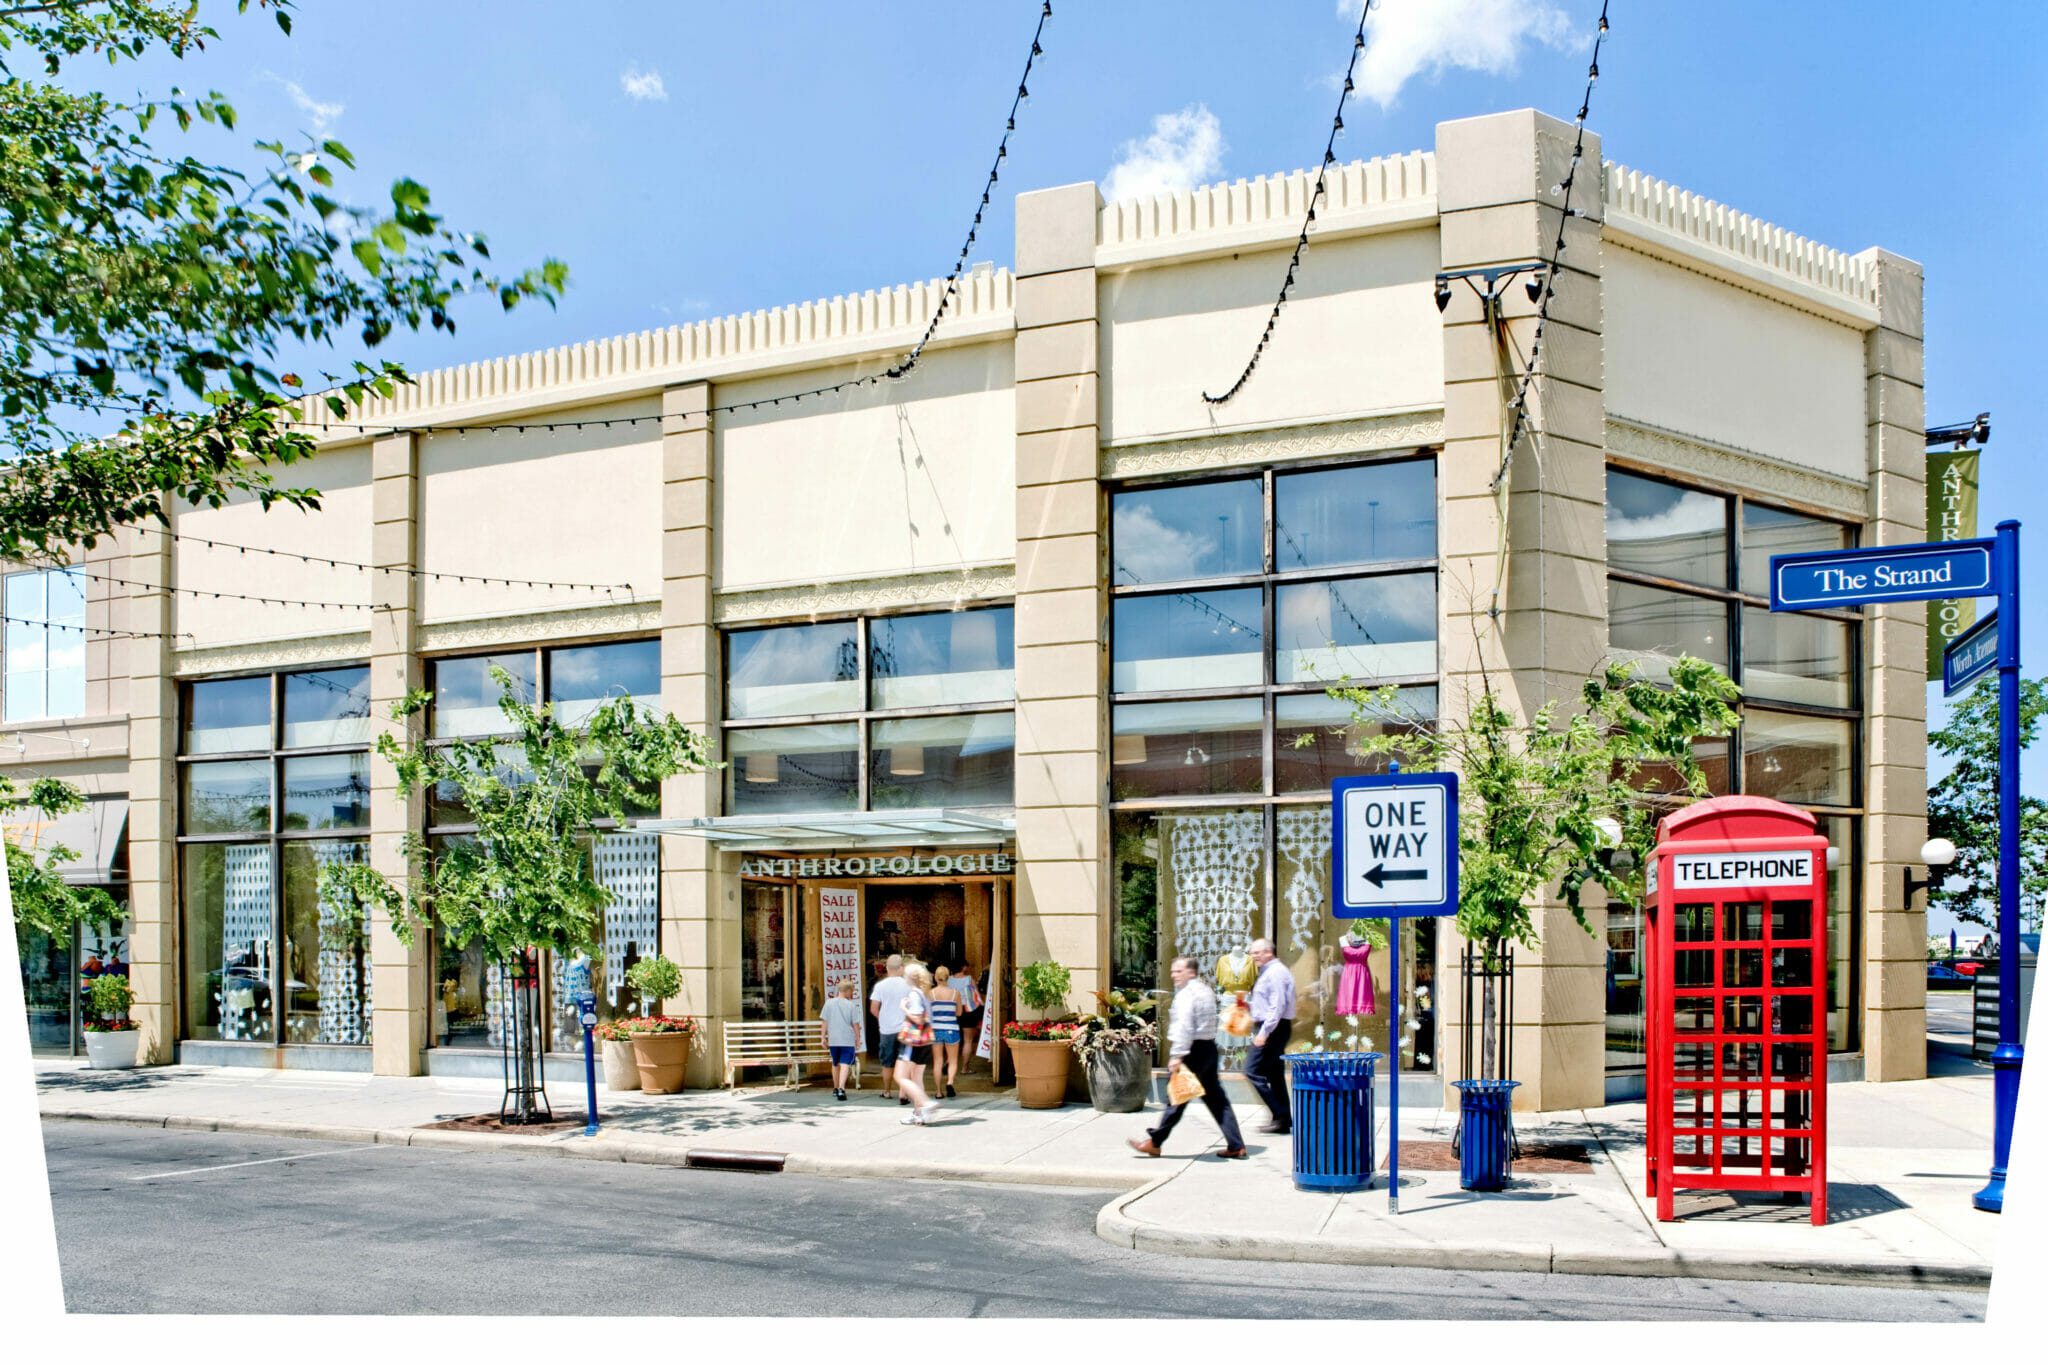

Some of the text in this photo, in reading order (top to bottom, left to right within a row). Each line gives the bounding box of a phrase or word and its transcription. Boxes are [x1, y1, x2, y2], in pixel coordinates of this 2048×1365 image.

[1814, 561, 1952, 592] The Strand
[1365, 801, 1426, 828] ONE
[1369, 832, 1429, 859] WAY
[736, 853, 1011, 878] ANTHROPOLOGIE
[1678, 858, 1808, 881] TELEPHONE
[822, 895, 855, 907] SALE
[823, 911, 855, 923] SALE
[824, 927, 856, 938] SALE
[825, 943, 857, 955] SALE
[825, 958, 858, 971] SALE
